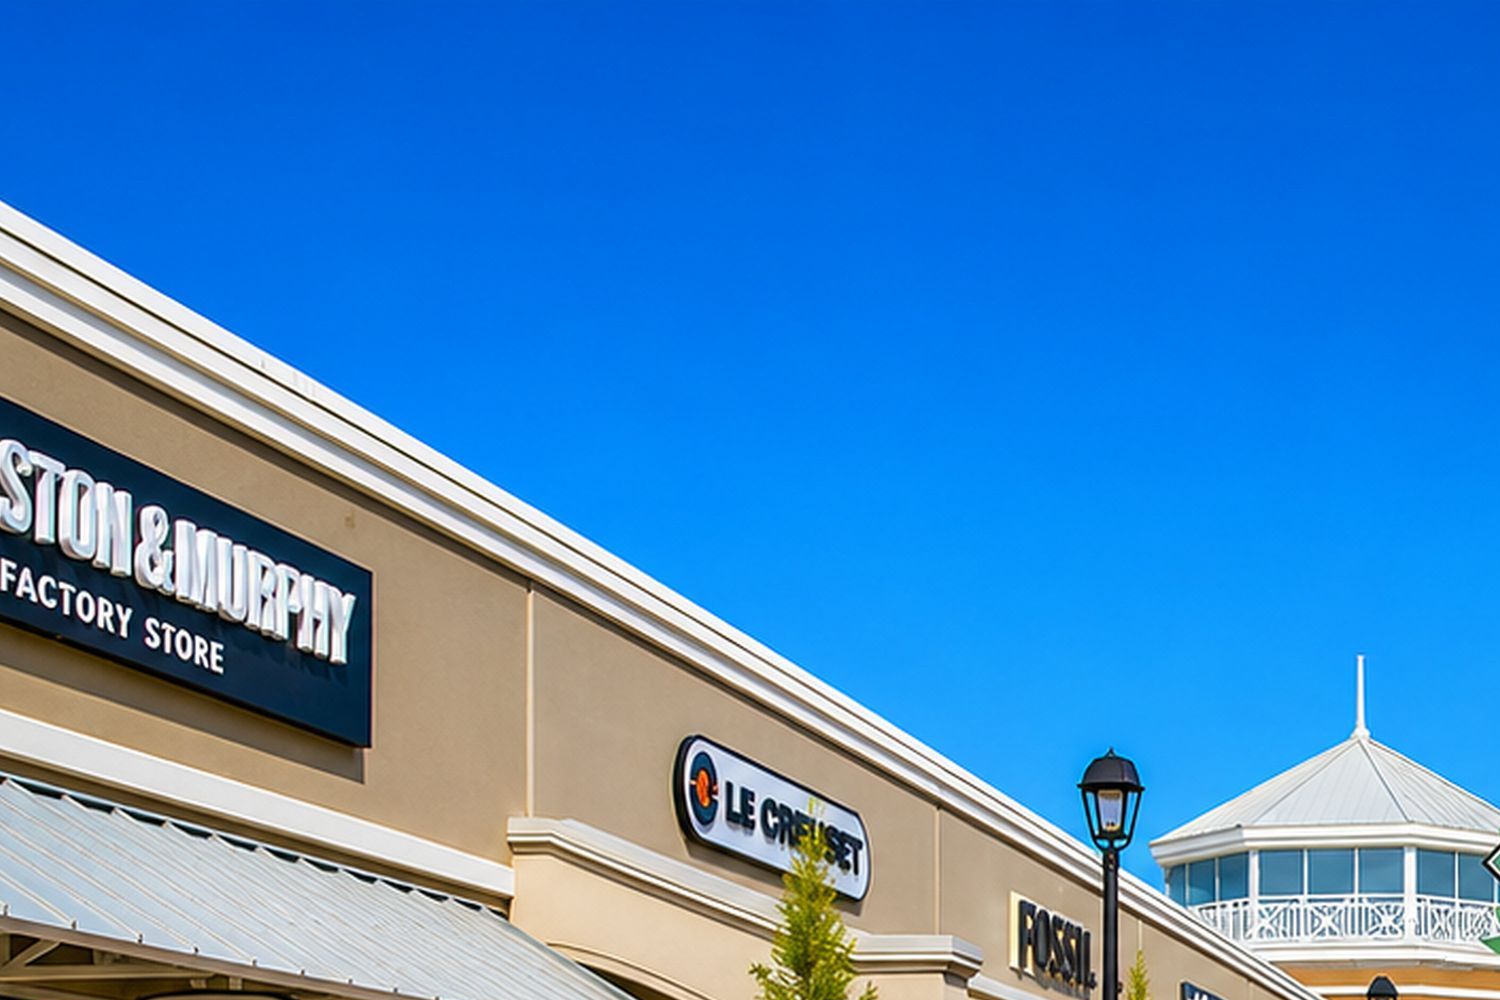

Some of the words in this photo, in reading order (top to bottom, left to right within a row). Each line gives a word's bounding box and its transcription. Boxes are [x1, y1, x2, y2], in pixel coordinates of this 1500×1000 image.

[0, 557, 133, 639] FACTORY
[144, 617, 224, 675] STORE
[134, 505, 175, 596] &
[175, 519, 357, 665] MURPHY
[725, 781, 756, 831] LE
[1019, 900, 1098, 989] FOSSIL
